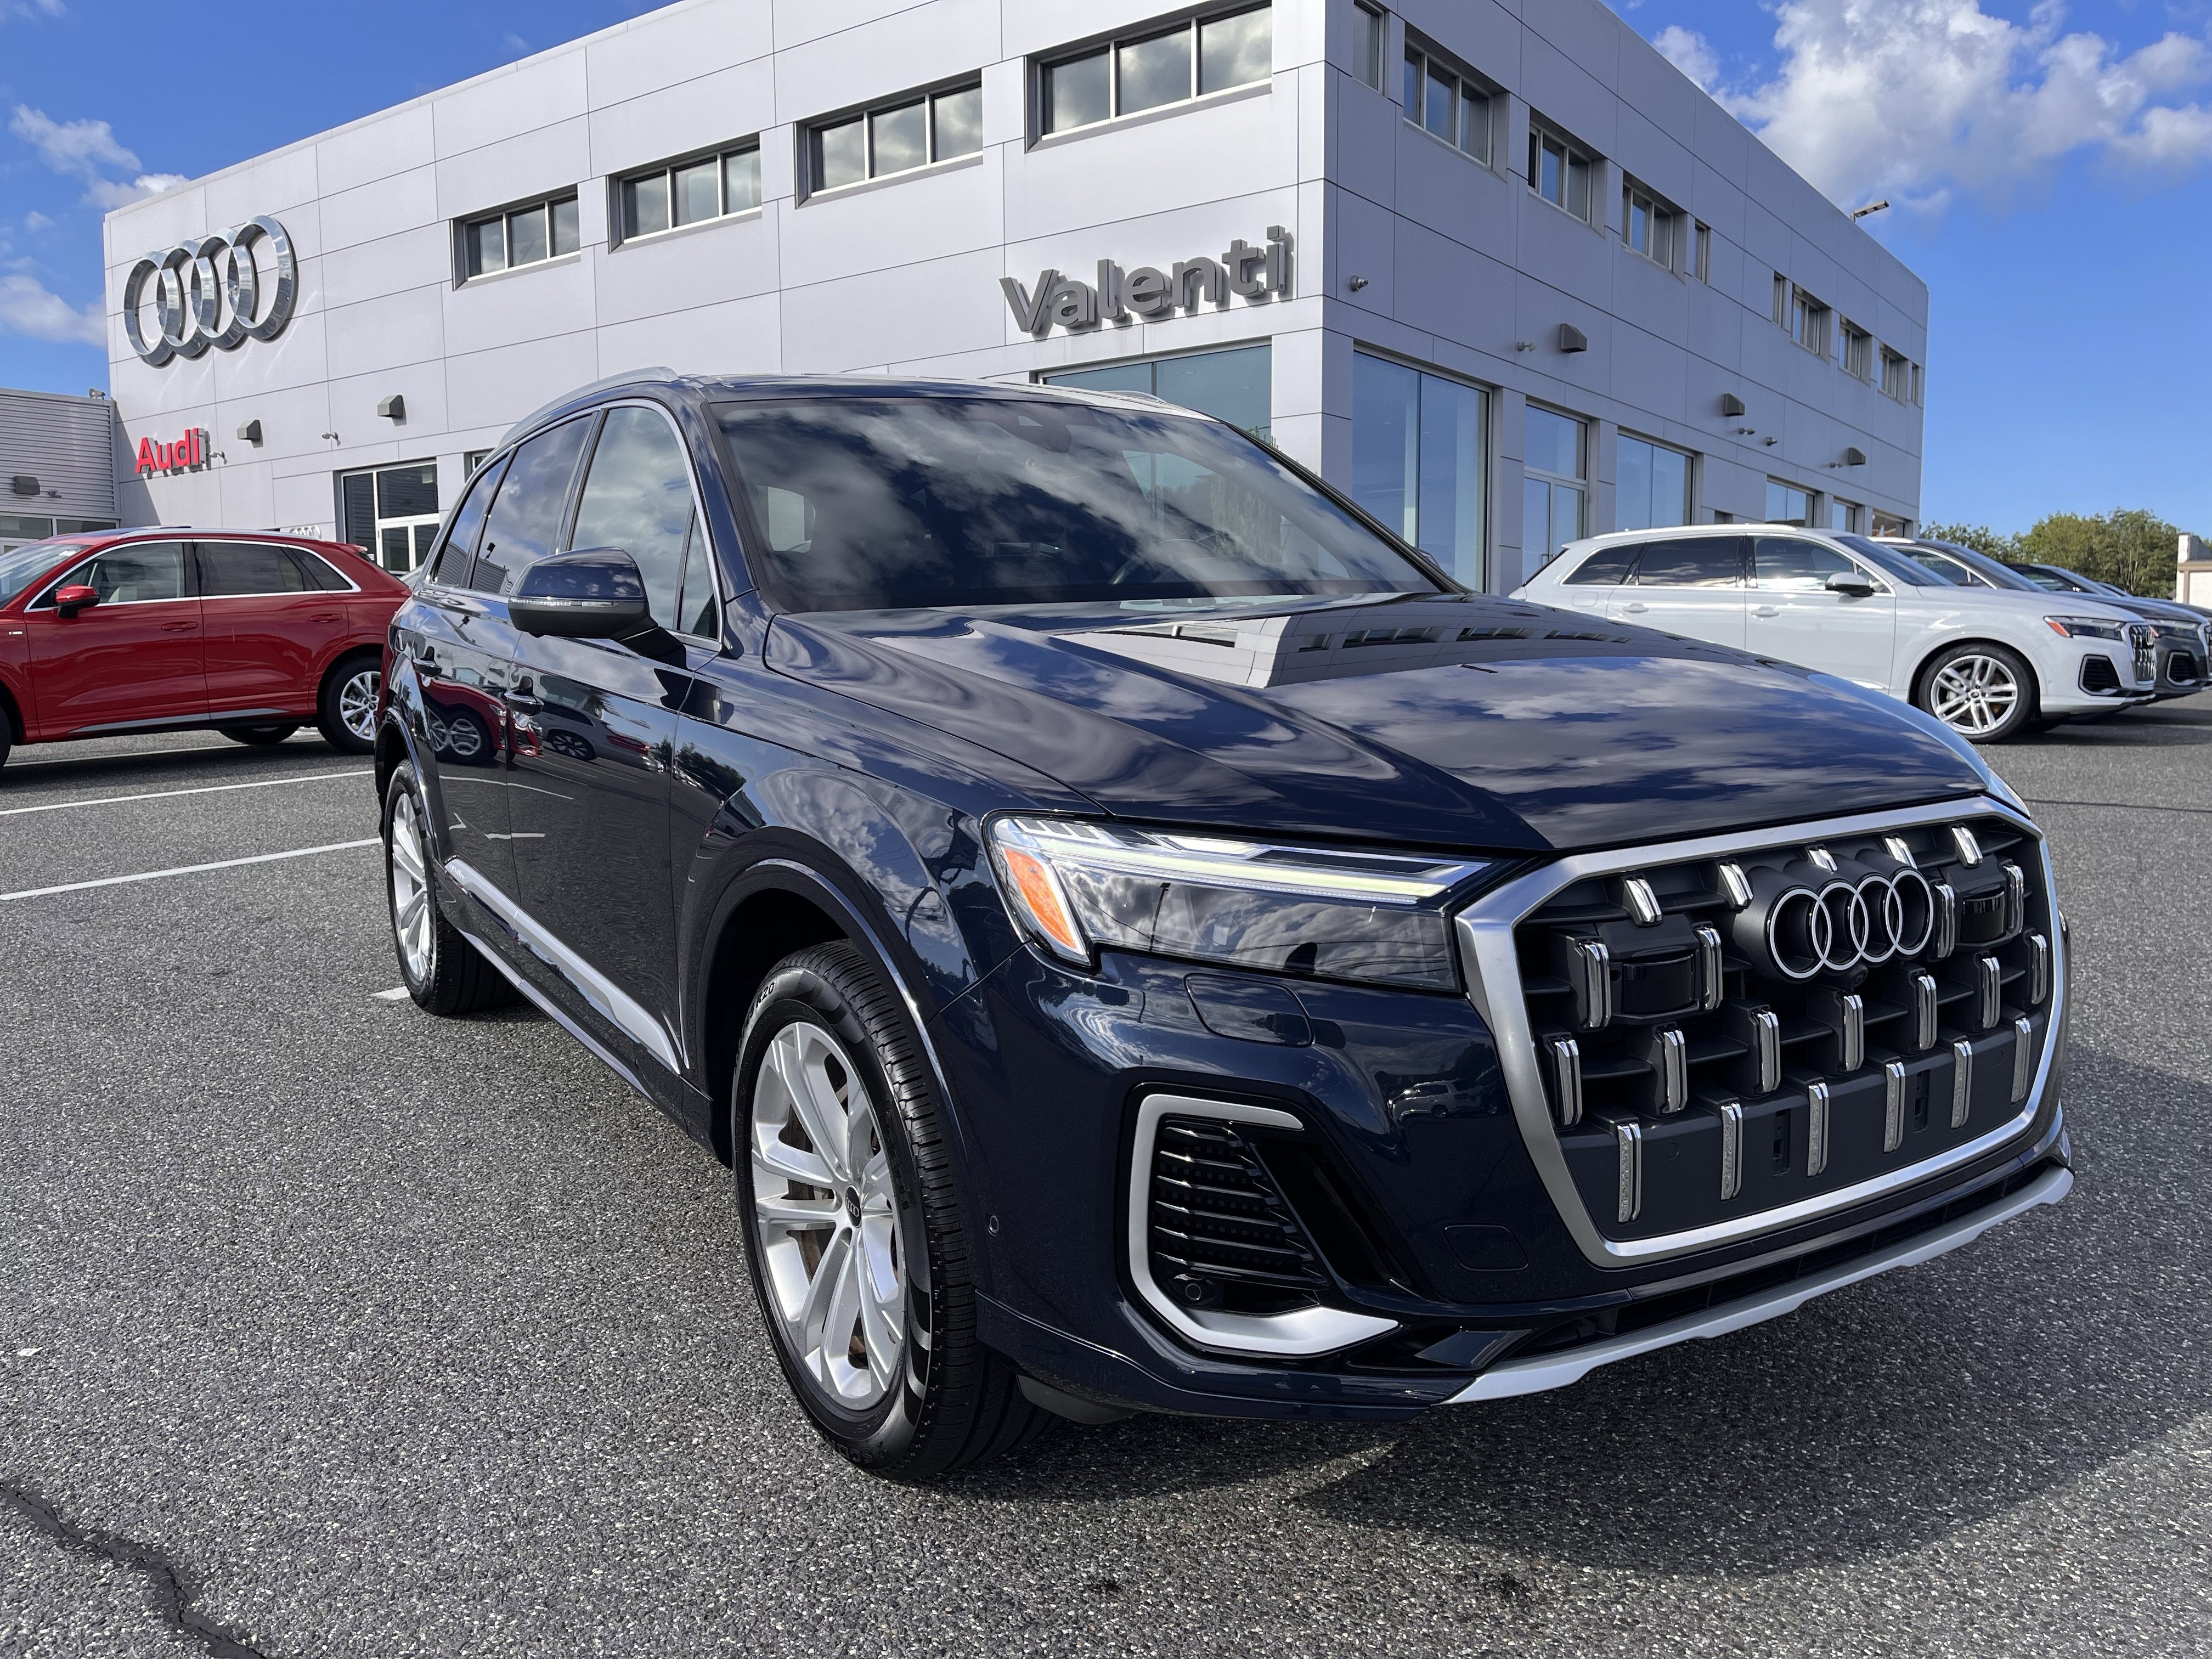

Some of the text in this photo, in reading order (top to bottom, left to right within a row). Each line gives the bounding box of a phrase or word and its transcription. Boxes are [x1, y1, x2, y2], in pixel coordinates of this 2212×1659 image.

[998, 225, 1286, 333] Valenti
[136, 427, 202, 473] Audi
[755, 981, 775, 1008] R20
